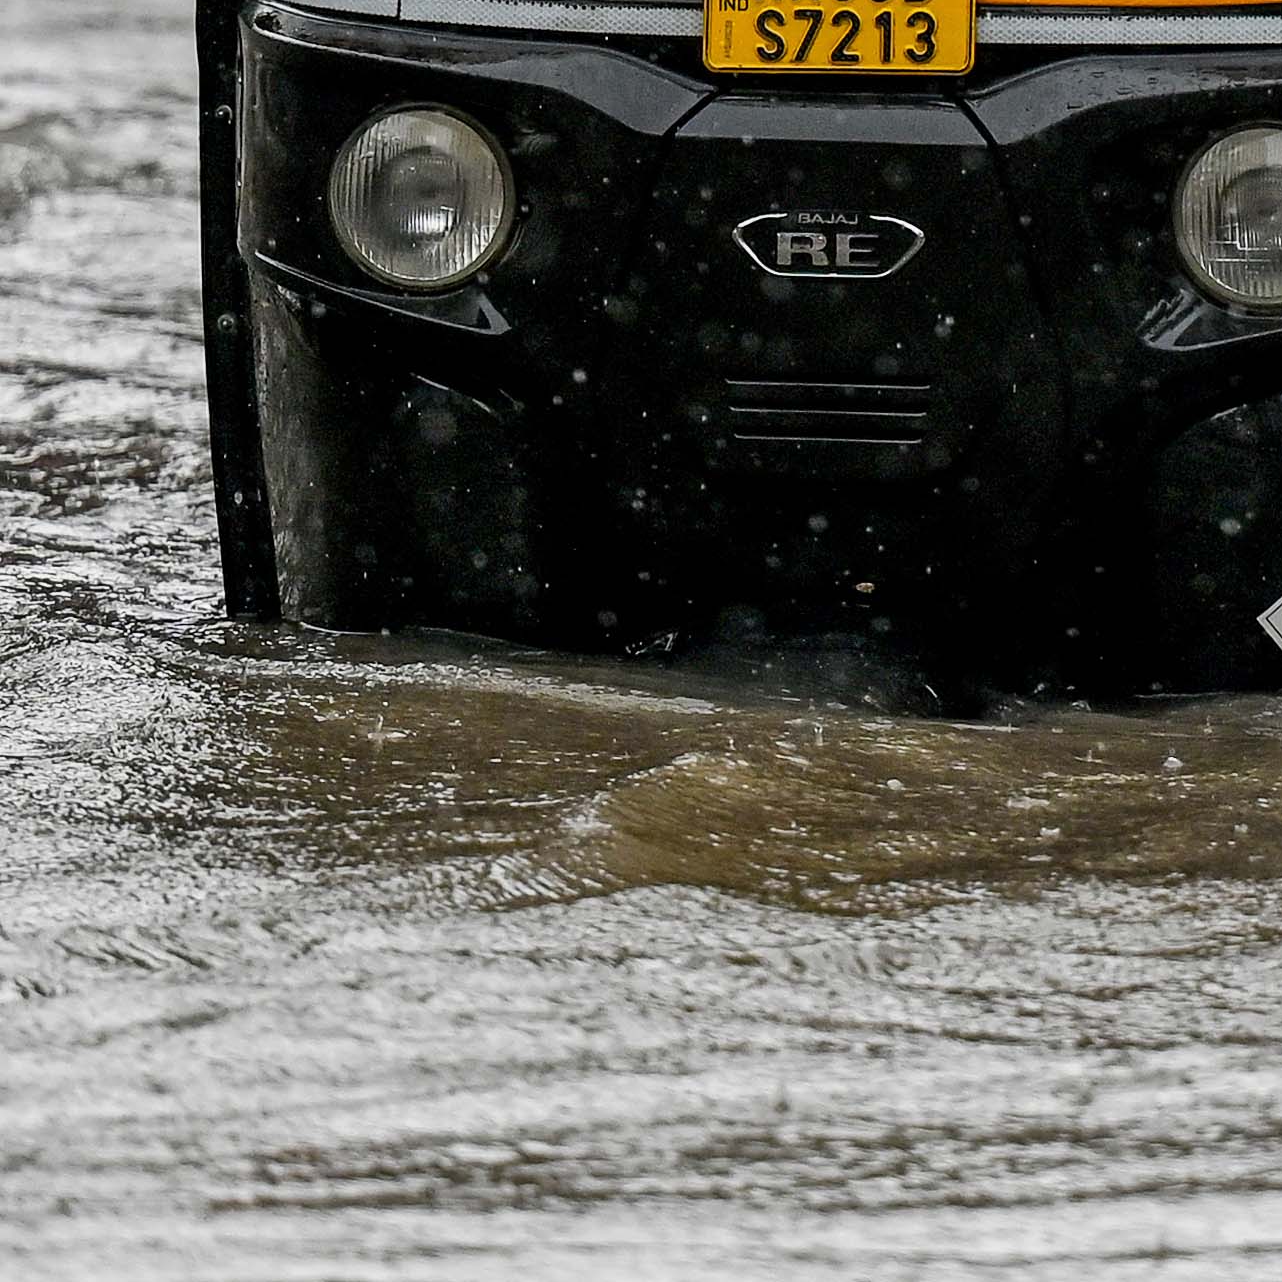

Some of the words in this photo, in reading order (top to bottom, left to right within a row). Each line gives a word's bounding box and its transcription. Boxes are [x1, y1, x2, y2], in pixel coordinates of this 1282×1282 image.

[755, 9, 937, 63] S7213
[798, 213, 858, 225] BAJAJ
[776, 231, 881, 267] RE
